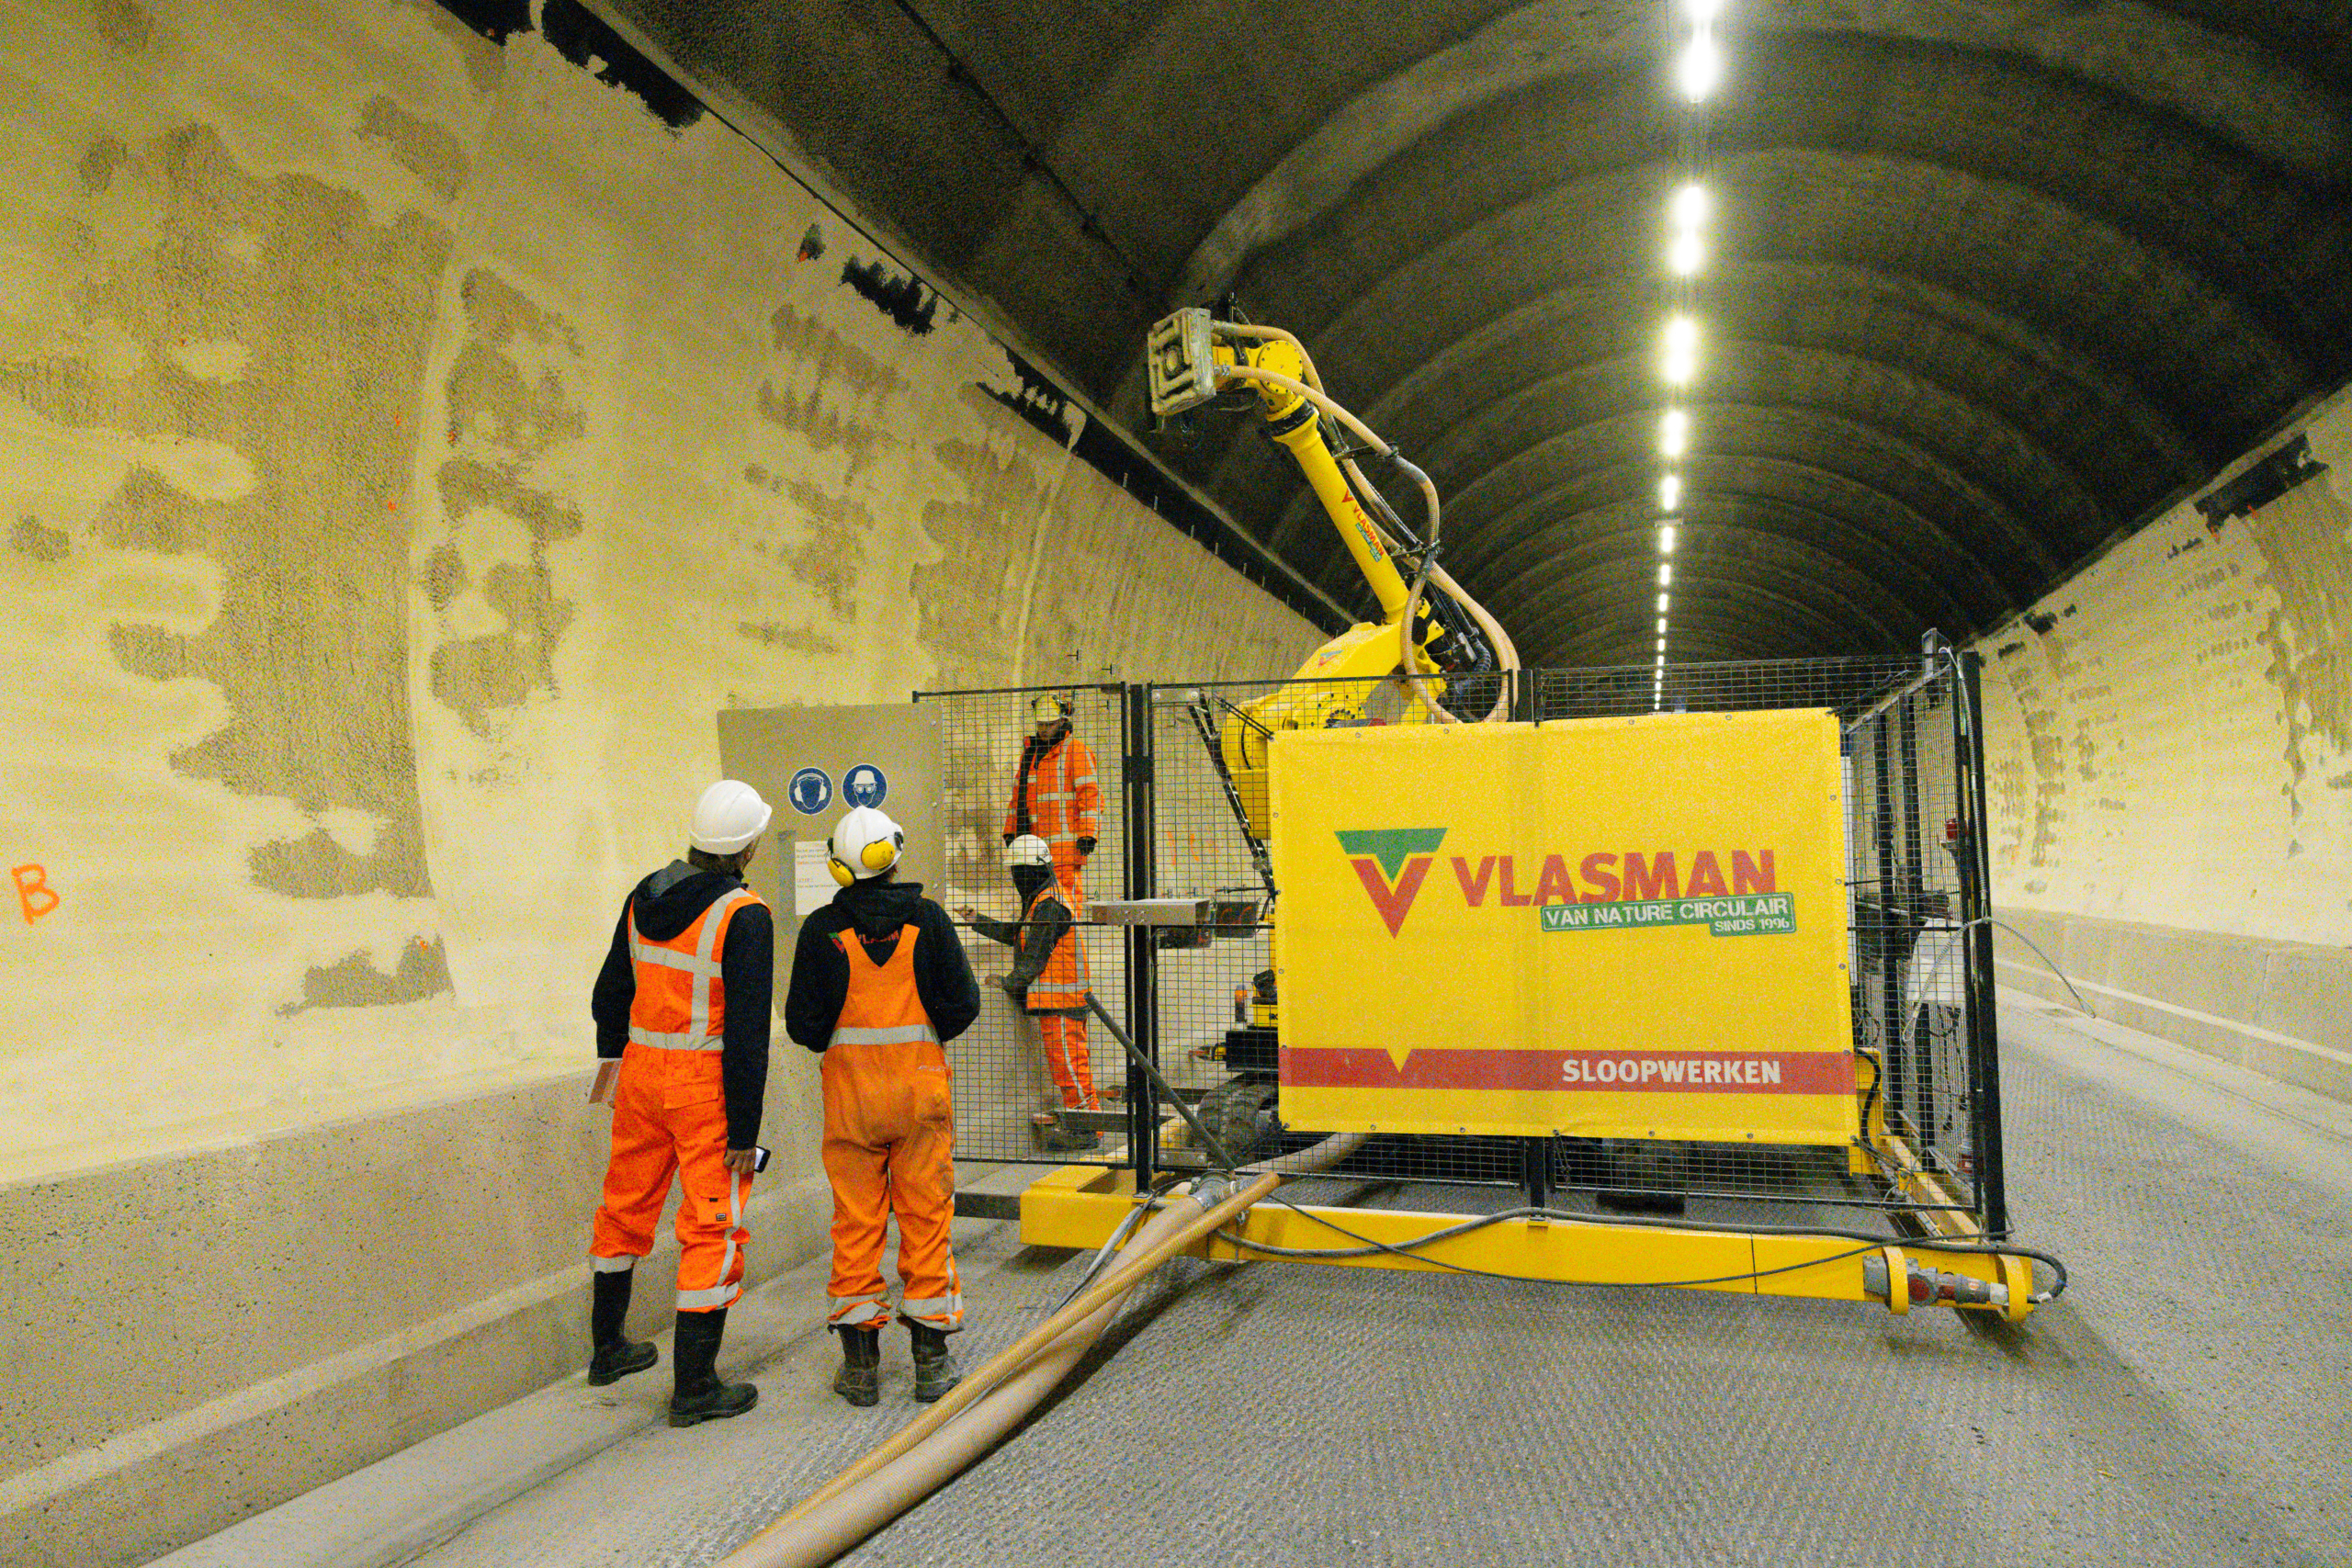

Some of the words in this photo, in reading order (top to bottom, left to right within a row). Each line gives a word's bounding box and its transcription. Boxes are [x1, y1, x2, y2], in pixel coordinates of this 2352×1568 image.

[1353, 502, 1385, 557] VLASMAN
[11, 863, 61, 925] B
[1450, 850, 1776, 908] VLASMAN
[1545, 908, 1589, 927] VAN
[1594, 904, 1674, 924] NATURE
[1679, 897, 1789, 919] CIRCULAIR
[1714, 919, 1756, 932] SINDS
[1760, 918, 1790, 931] 1996
[1563, 1059, 1781, 1084] SLOOPWERKEN
